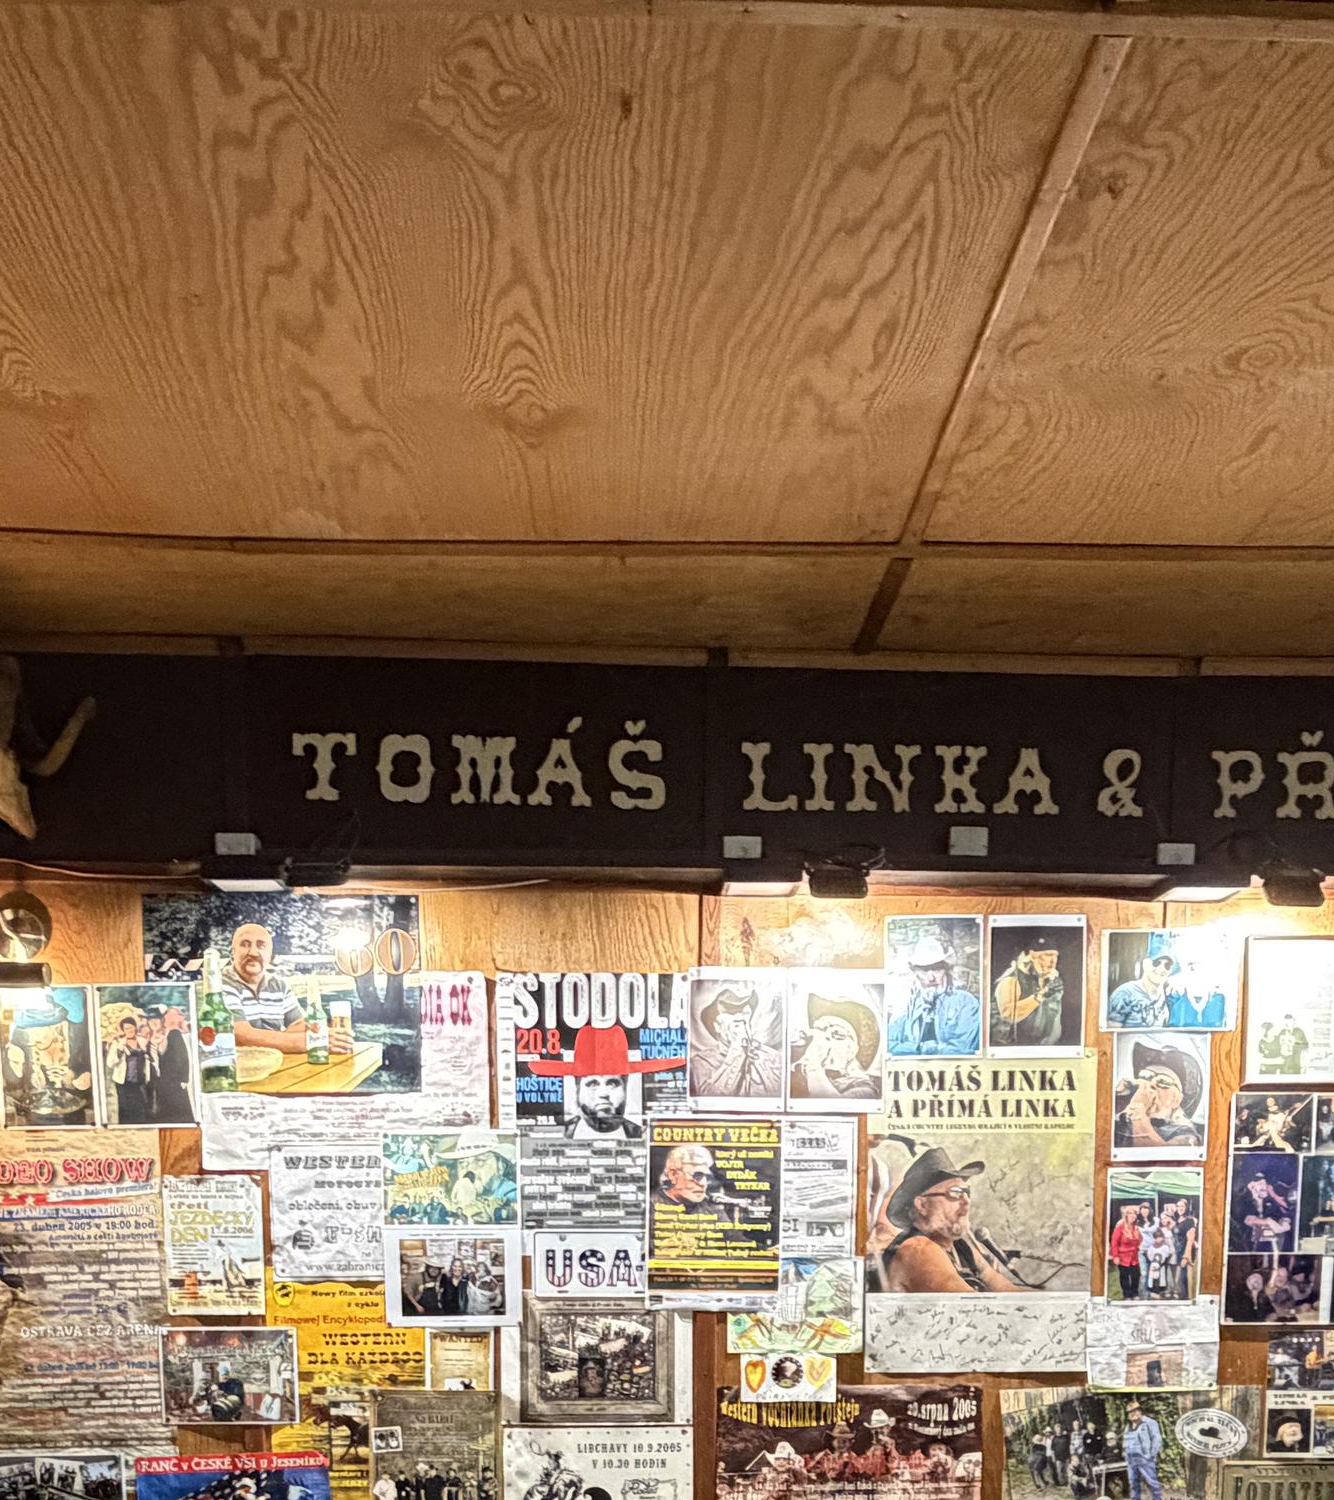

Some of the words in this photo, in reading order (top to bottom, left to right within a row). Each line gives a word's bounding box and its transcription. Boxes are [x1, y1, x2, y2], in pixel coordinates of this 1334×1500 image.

[292, 716, 666, 809] TOMÁŠ
[742, 741, 1060, 814] LINKA
[1097, 748, 1142, 818] &
[888, 1065, 984, 1092] TOMÁŠ
[991, 1069, 1078, 1092] LINKA
[888, 1101, 904, 1119] A
[912, 1094, 993, 1118] PŘÍMÁ
[1000, 1099, 1076, 1118] LINKA
[653, 1127, 726, 1143] COUNTRY
[728, 1126, 780, 1143] VEČER
[62, 1157, 154, 1184] SHOW
[20, 1325, 84, 1339] OSTRAVA
[577, 1442, 629, 1454] LIBCHAVY
[140, 1456, 179, 1472] RANČ
[191, 1455, 232, 1472] ČESKÉ
